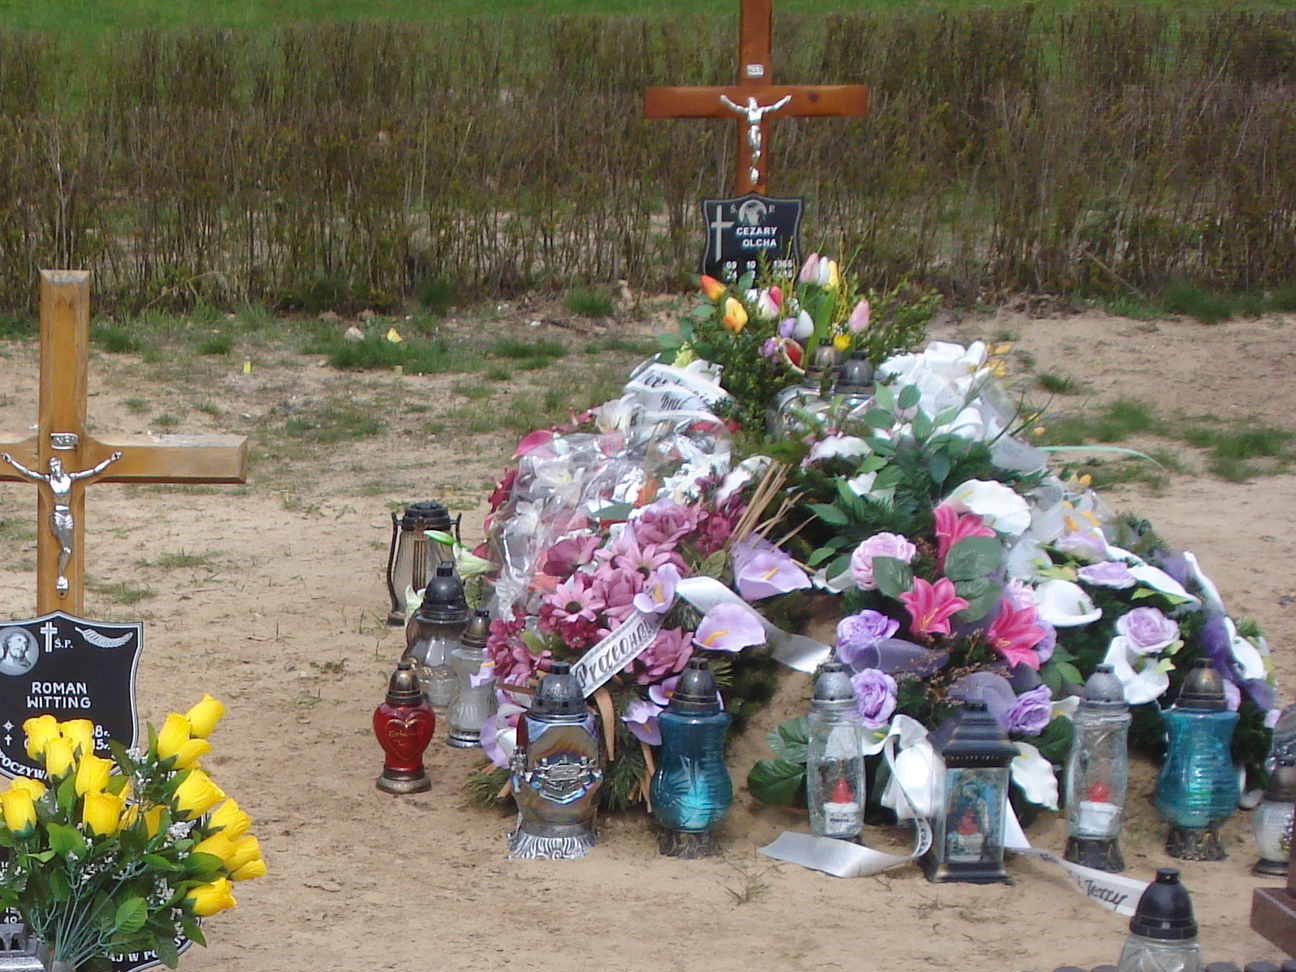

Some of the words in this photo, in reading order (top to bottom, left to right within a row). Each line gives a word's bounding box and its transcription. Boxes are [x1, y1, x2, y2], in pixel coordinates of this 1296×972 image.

[736, 226, 778, 236] CEZARY
[742, 238, 777, 247] OLCHA
[31, 681, 87, 695] ROMAN
[26, 696, 92, 710] WITTING
